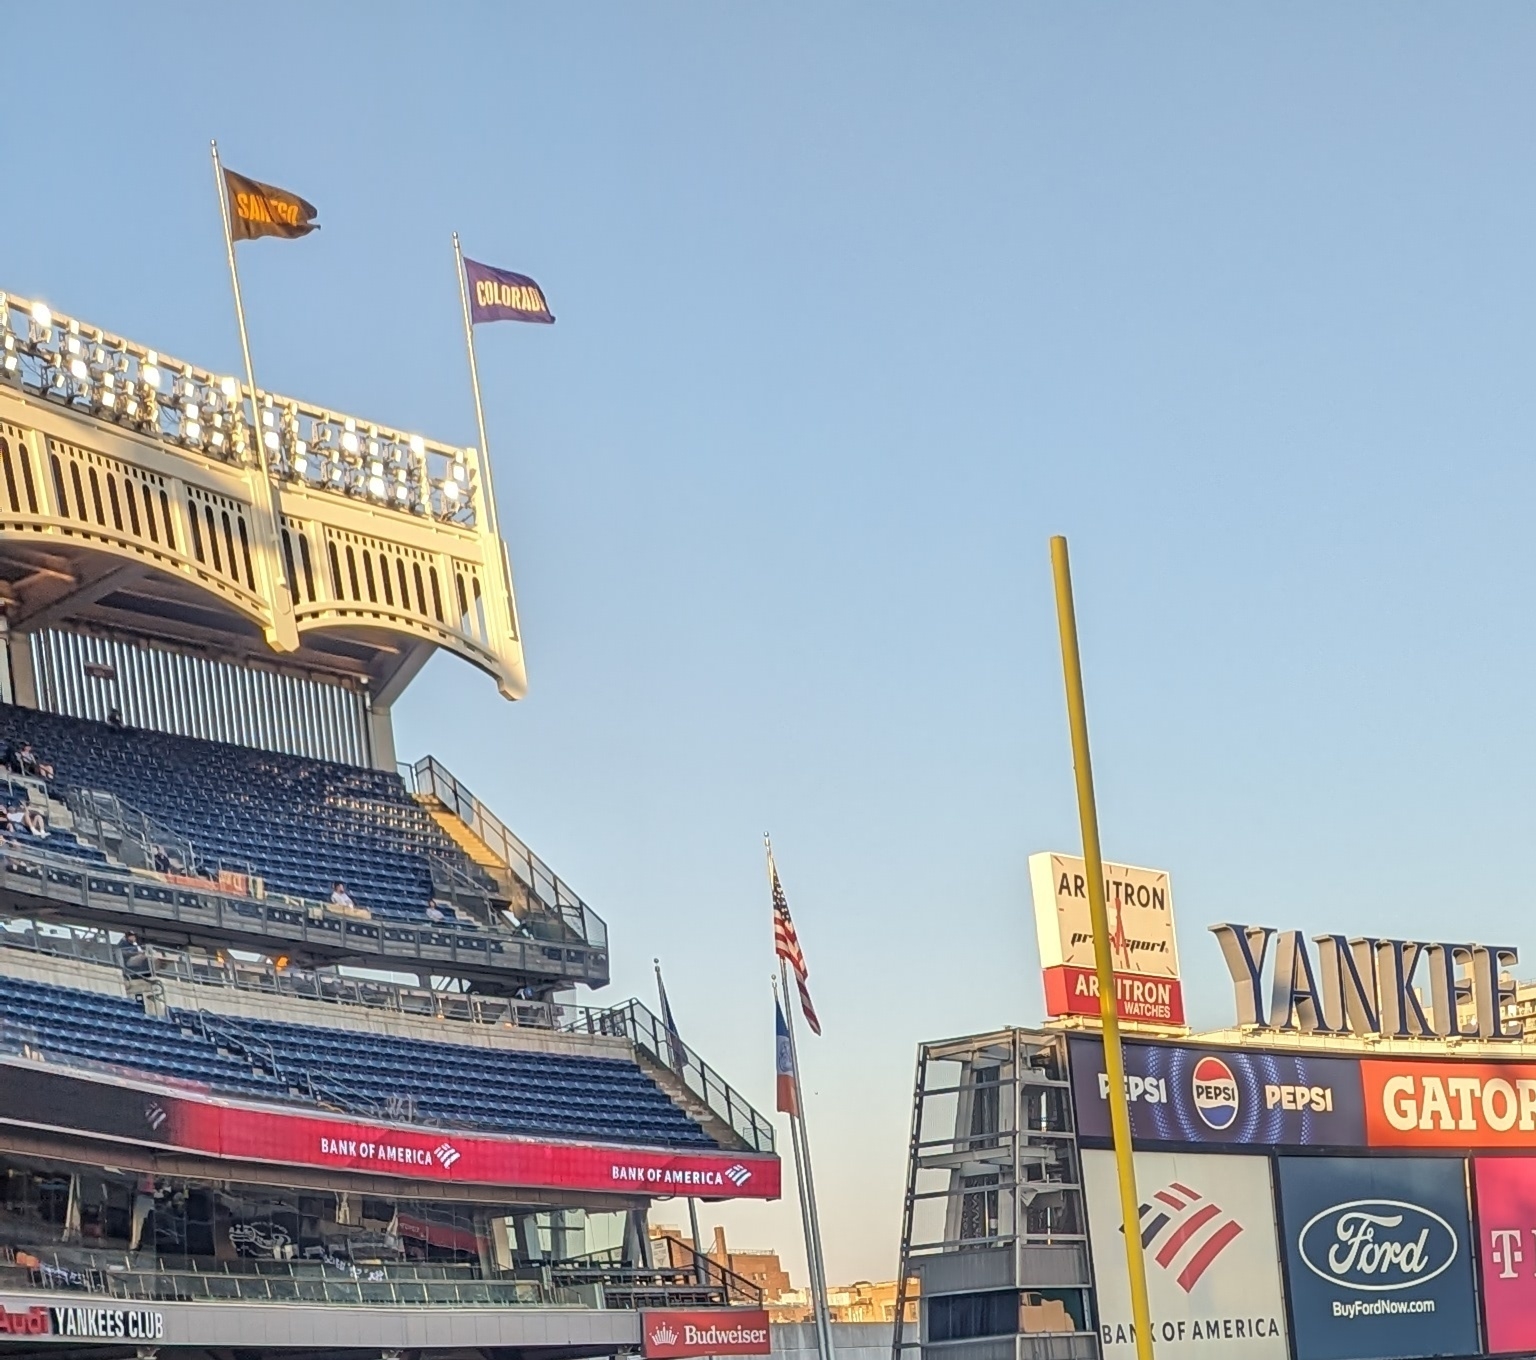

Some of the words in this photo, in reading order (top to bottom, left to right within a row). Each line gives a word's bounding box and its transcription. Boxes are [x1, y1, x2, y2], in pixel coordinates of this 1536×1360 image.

[1058, 872, 1165, 910] ARITRON
[1075, 974, 1170, 1004] ARITRON
[1208, 922, 1524, 1041] YANKEE
[1124, 1001, 1170, 1018] WATCHES
[1195, 1084, 1236, 1102] PEPSI
[1265, 1085, 1333, 1112] PEPSI
[321, 1137, 357, 1157] BANK
[360, 1142, 375, 1158] OF
[378, 1145, 433, 1165] AMERICA
[612, 1165, 644, 1181] BANK
[647, 1169, 662, 1183] OF
[664, 1170, 723, 1185] AMERICA
[1329, 1211, 1430, 1275] Ford
[1332, 1299, 1436, 1319] BuyFordNow.com
[55, 1307, 124, 1337] YANKEES
[129, 1311, 164, 1339] CLUB
[684, 1325, 766, 1345] Budweiser
[1161, 1321, 1186, 1342] OF
[1191, 1317, 1280, 1340] AMERICA
